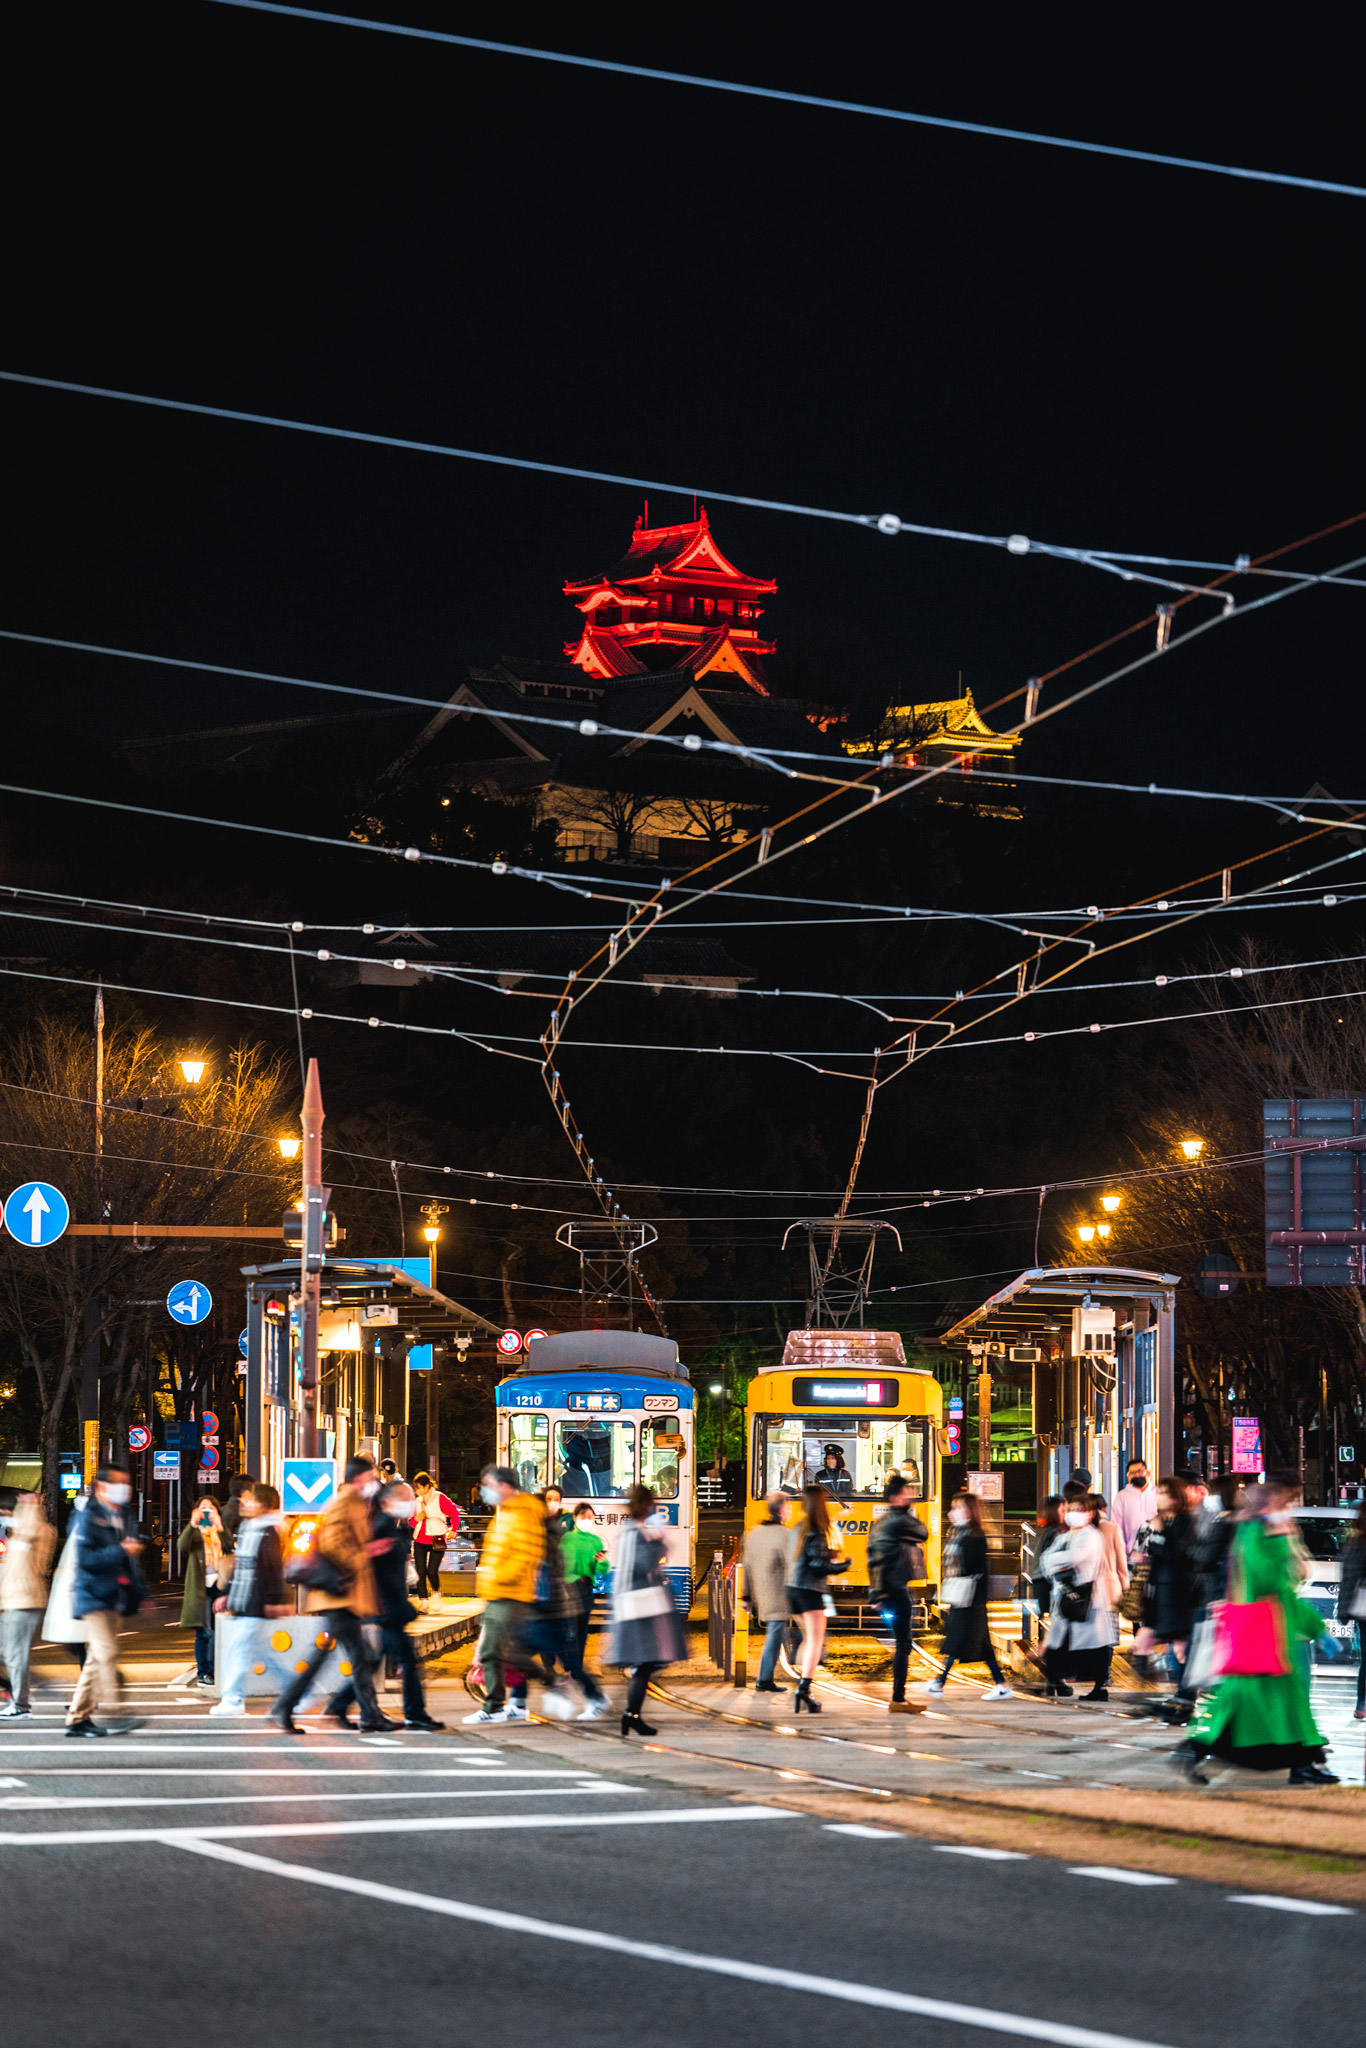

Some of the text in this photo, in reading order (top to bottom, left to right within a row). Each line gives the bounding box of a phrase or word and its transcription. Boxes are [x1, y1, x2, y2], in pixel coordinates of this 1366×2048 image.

[516, 1395, 542, 1406] 1210
[645, 1398, 677, 1408] ワンマン
